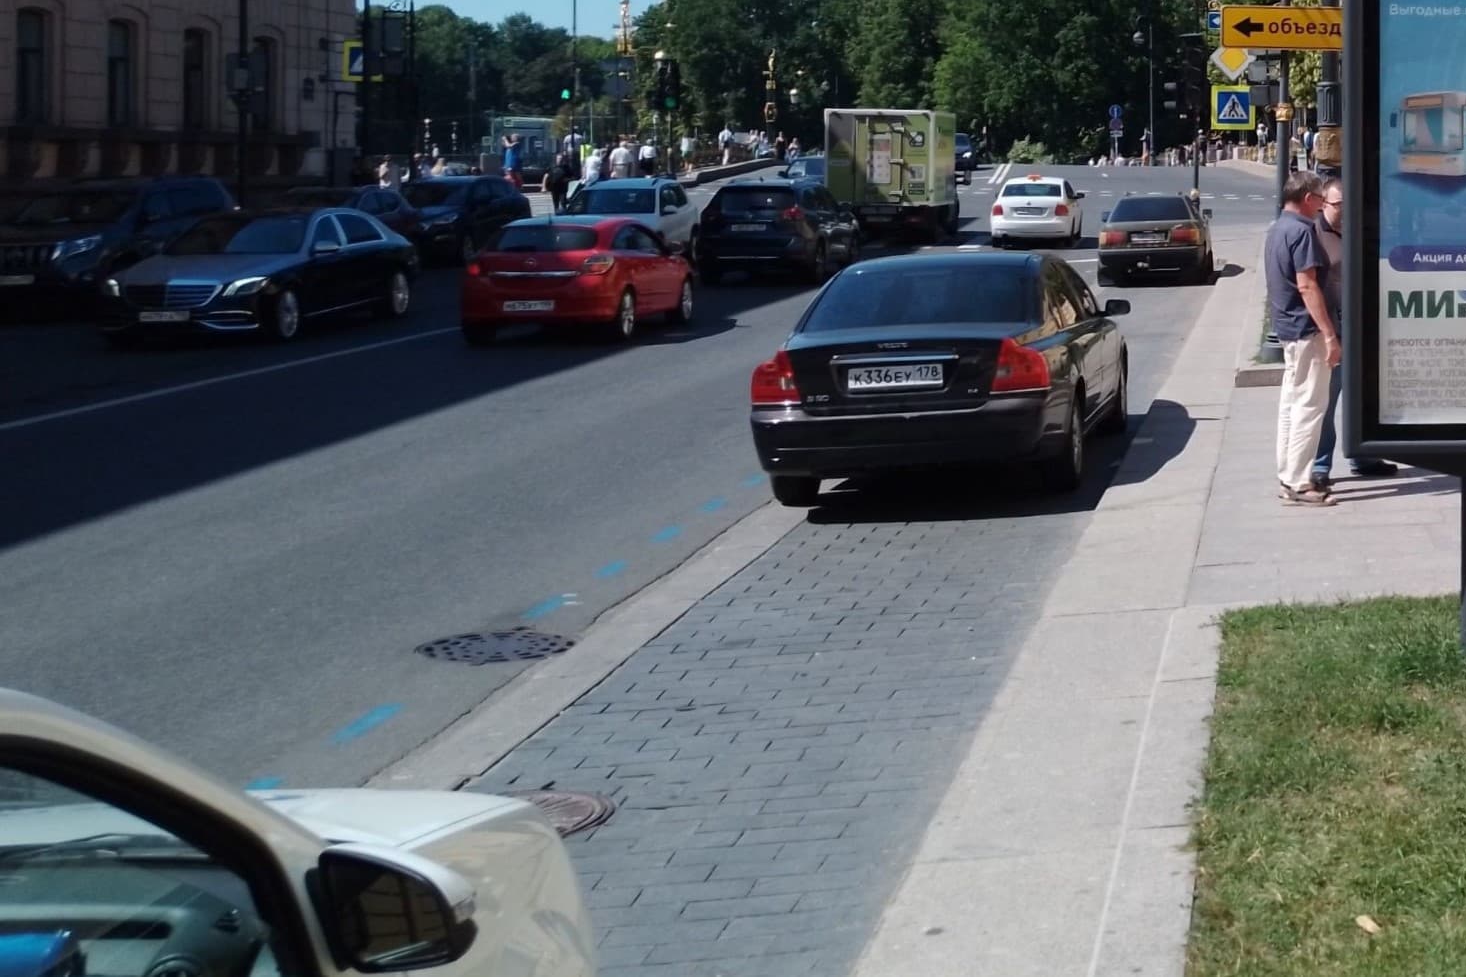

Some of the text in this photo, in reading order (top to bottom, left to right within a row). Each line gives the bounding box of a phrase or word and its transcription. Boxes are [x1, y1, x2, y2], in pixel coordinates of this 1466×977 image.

[1389, 3, 1462, 17] Выгодные
[1268, 17, 1342, 37] объезд
[1412, 252, 1452, 264] Акция
